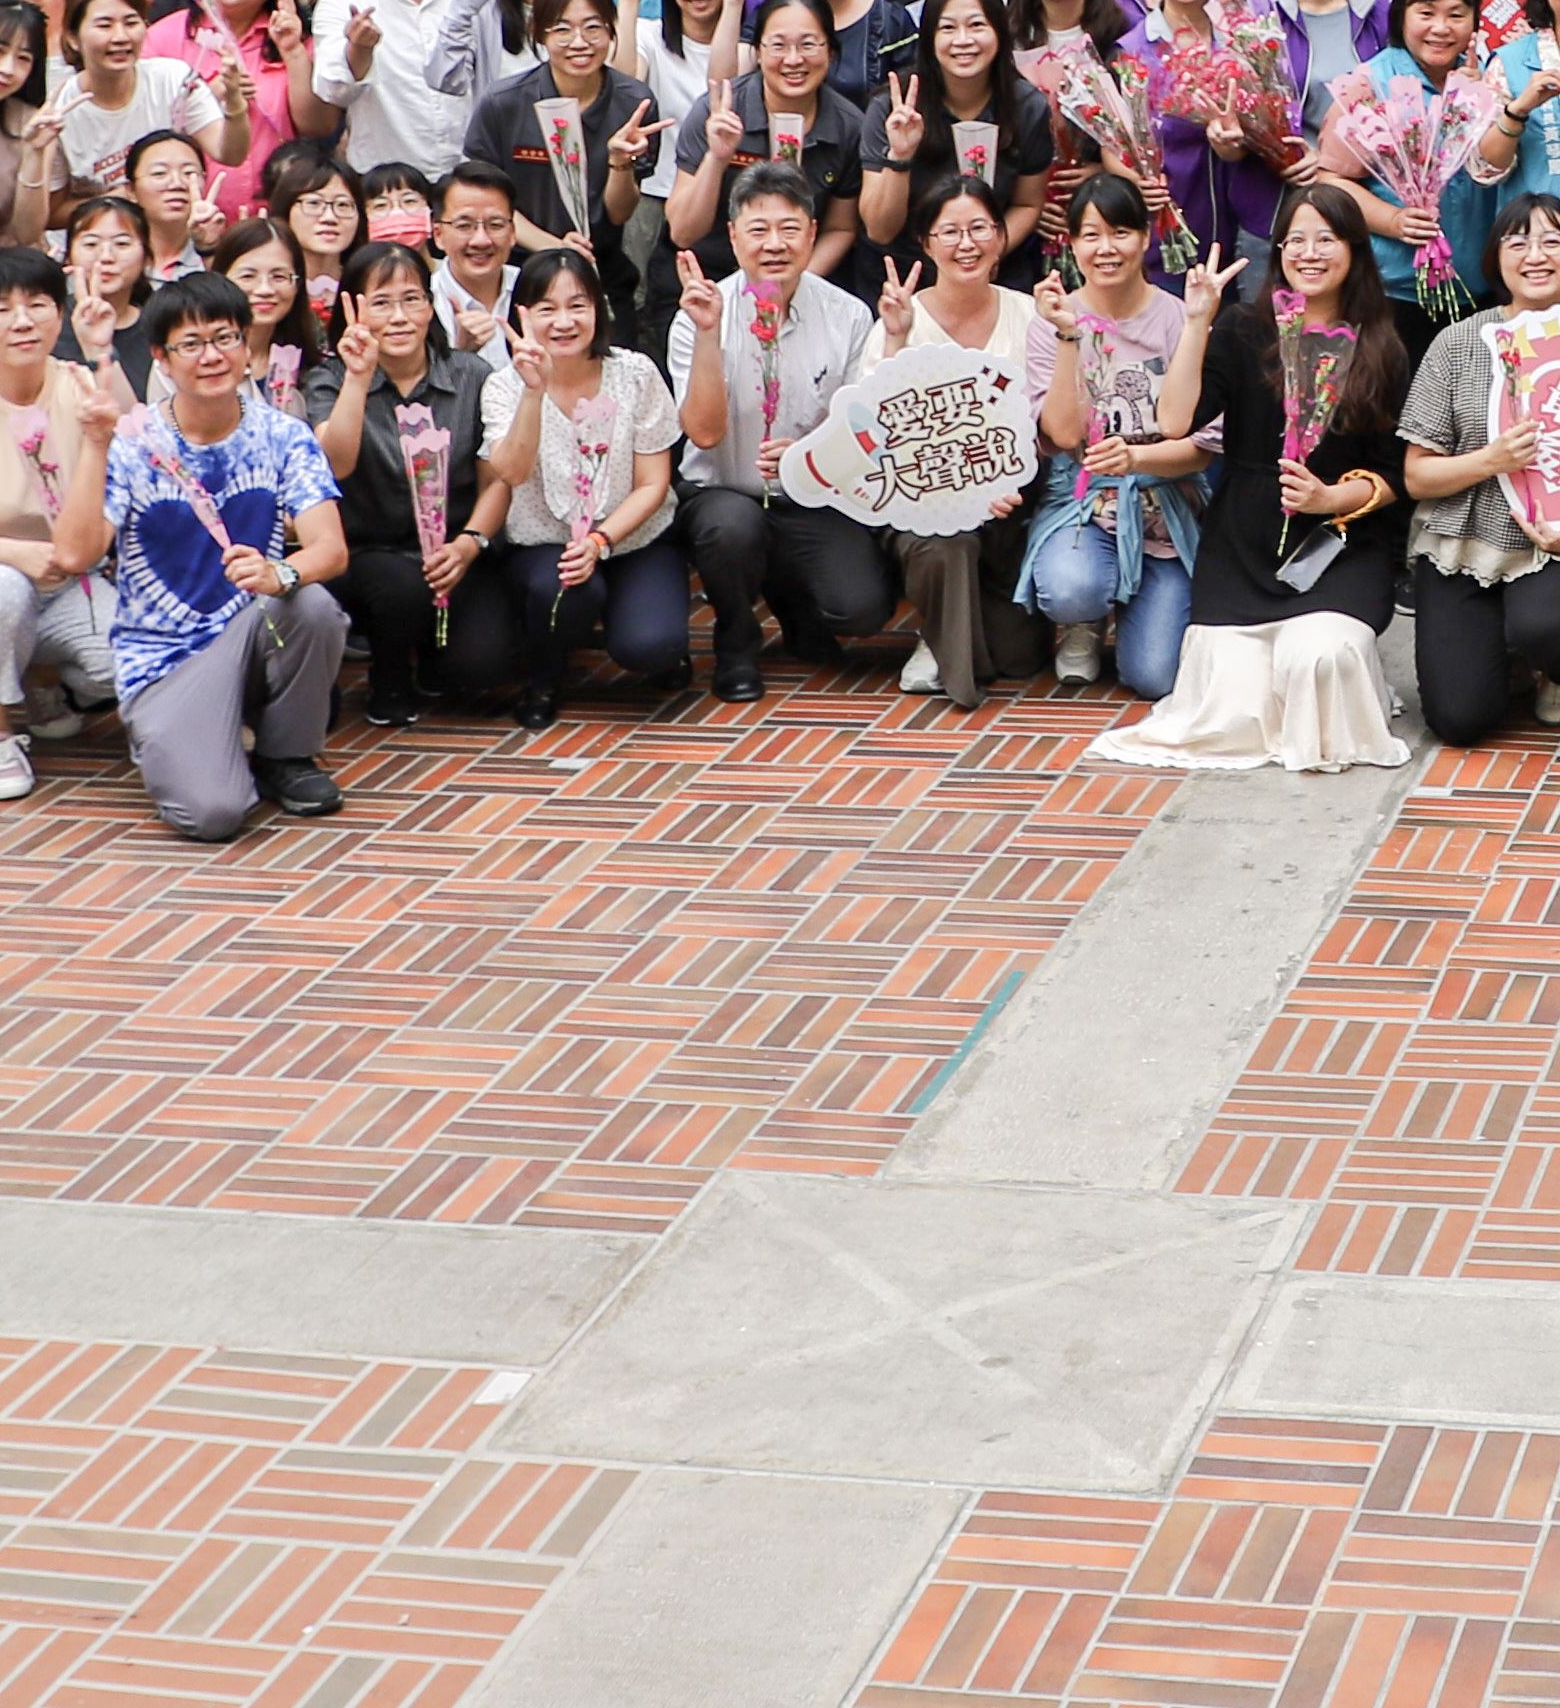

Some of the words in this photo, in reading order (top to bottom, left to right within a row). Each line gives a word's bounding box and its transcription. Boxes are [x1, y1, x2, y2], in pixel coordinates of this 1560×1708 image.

[878, 377, 984, 449] 愛要
[865, 428, 1024, 511] 大聲說
